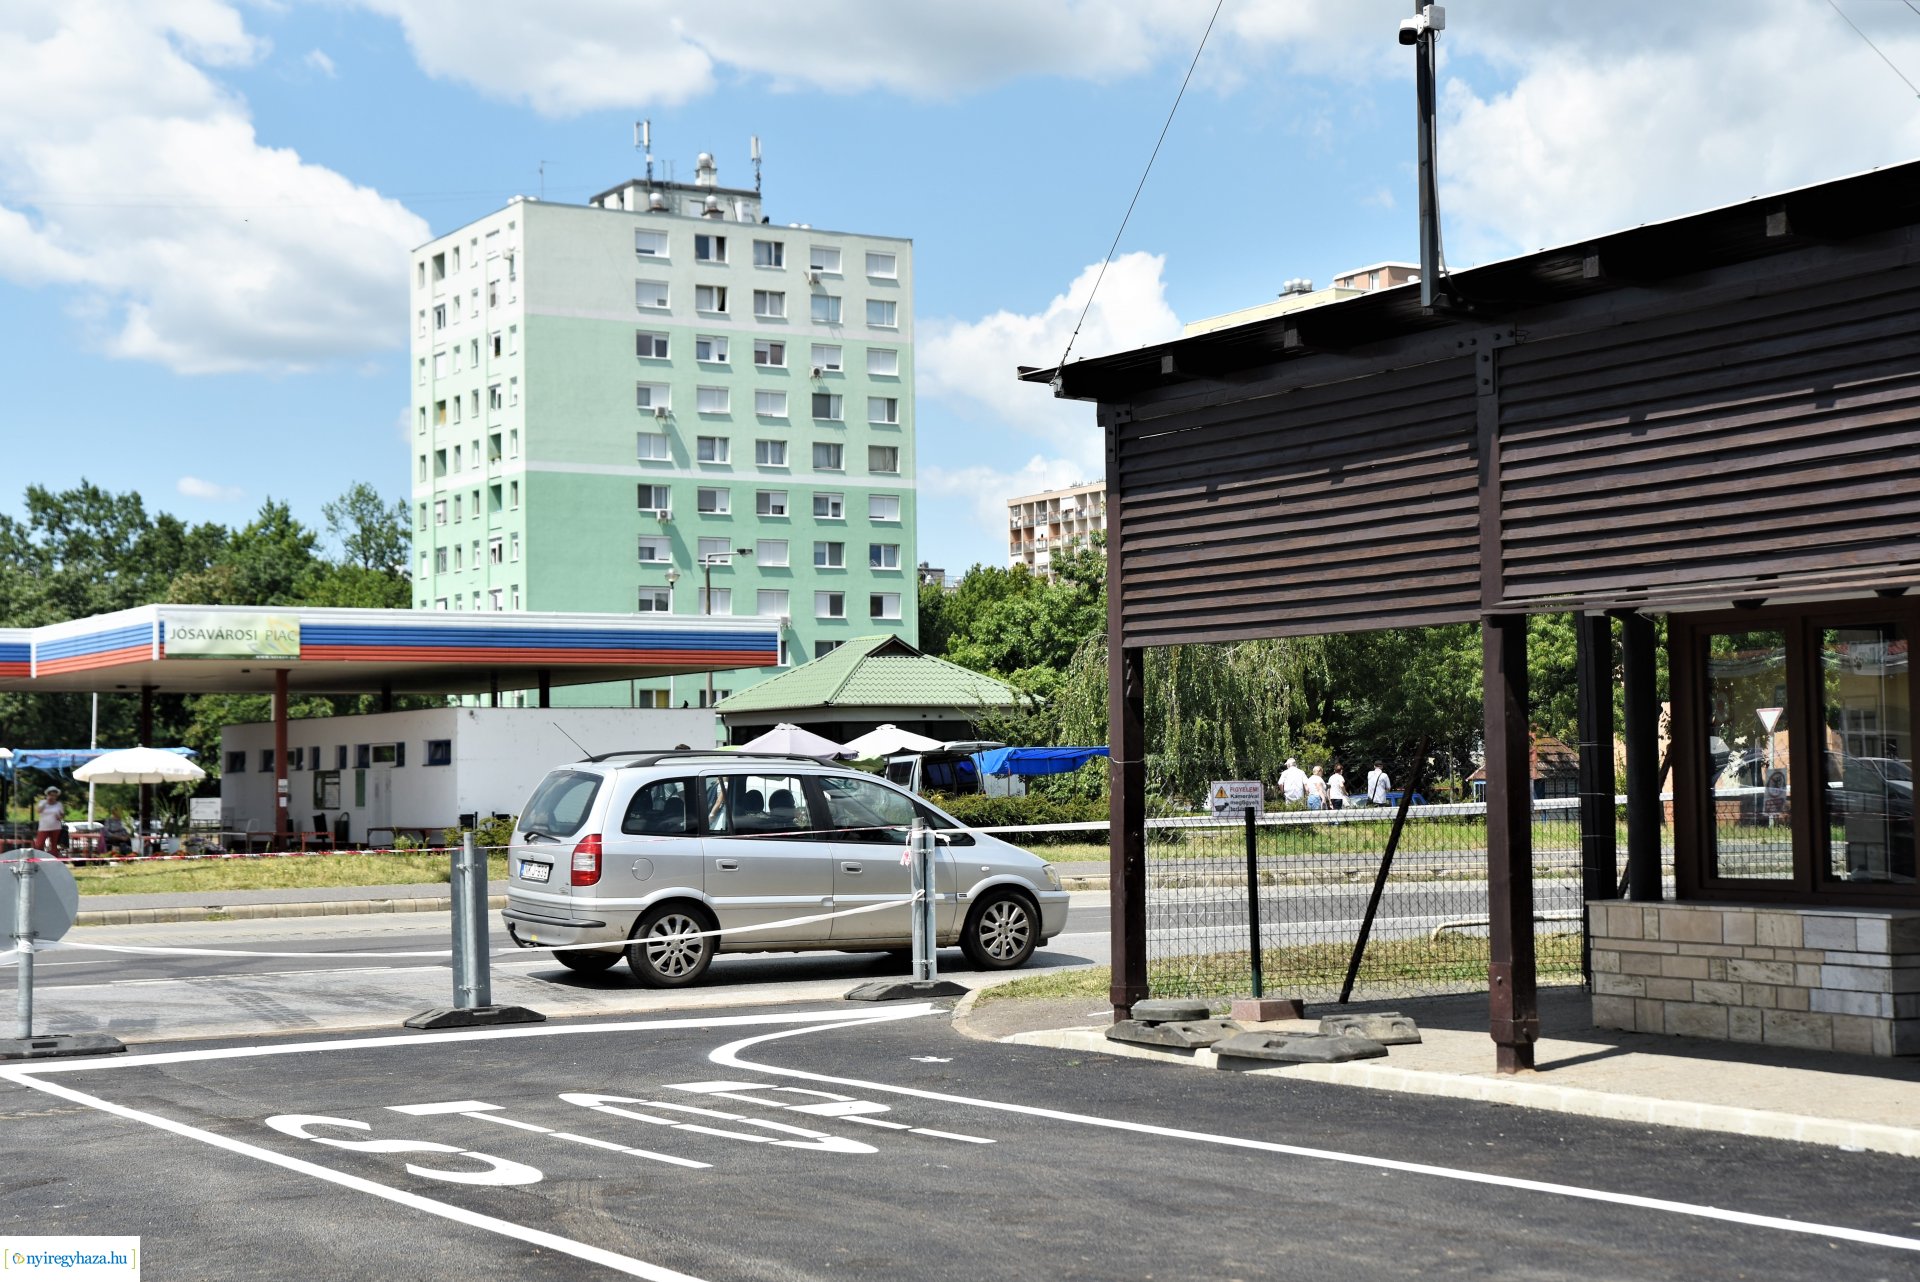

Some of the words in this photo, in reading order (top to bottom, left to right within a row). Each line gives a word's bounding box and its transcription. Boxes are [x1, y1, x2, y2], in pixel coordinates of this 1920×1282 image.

[170, 626, 257, 641] JÓSAVÁROSI
[265, 630, 296, 641] PIAC
[264, 1080, 998, 1186] STOP
